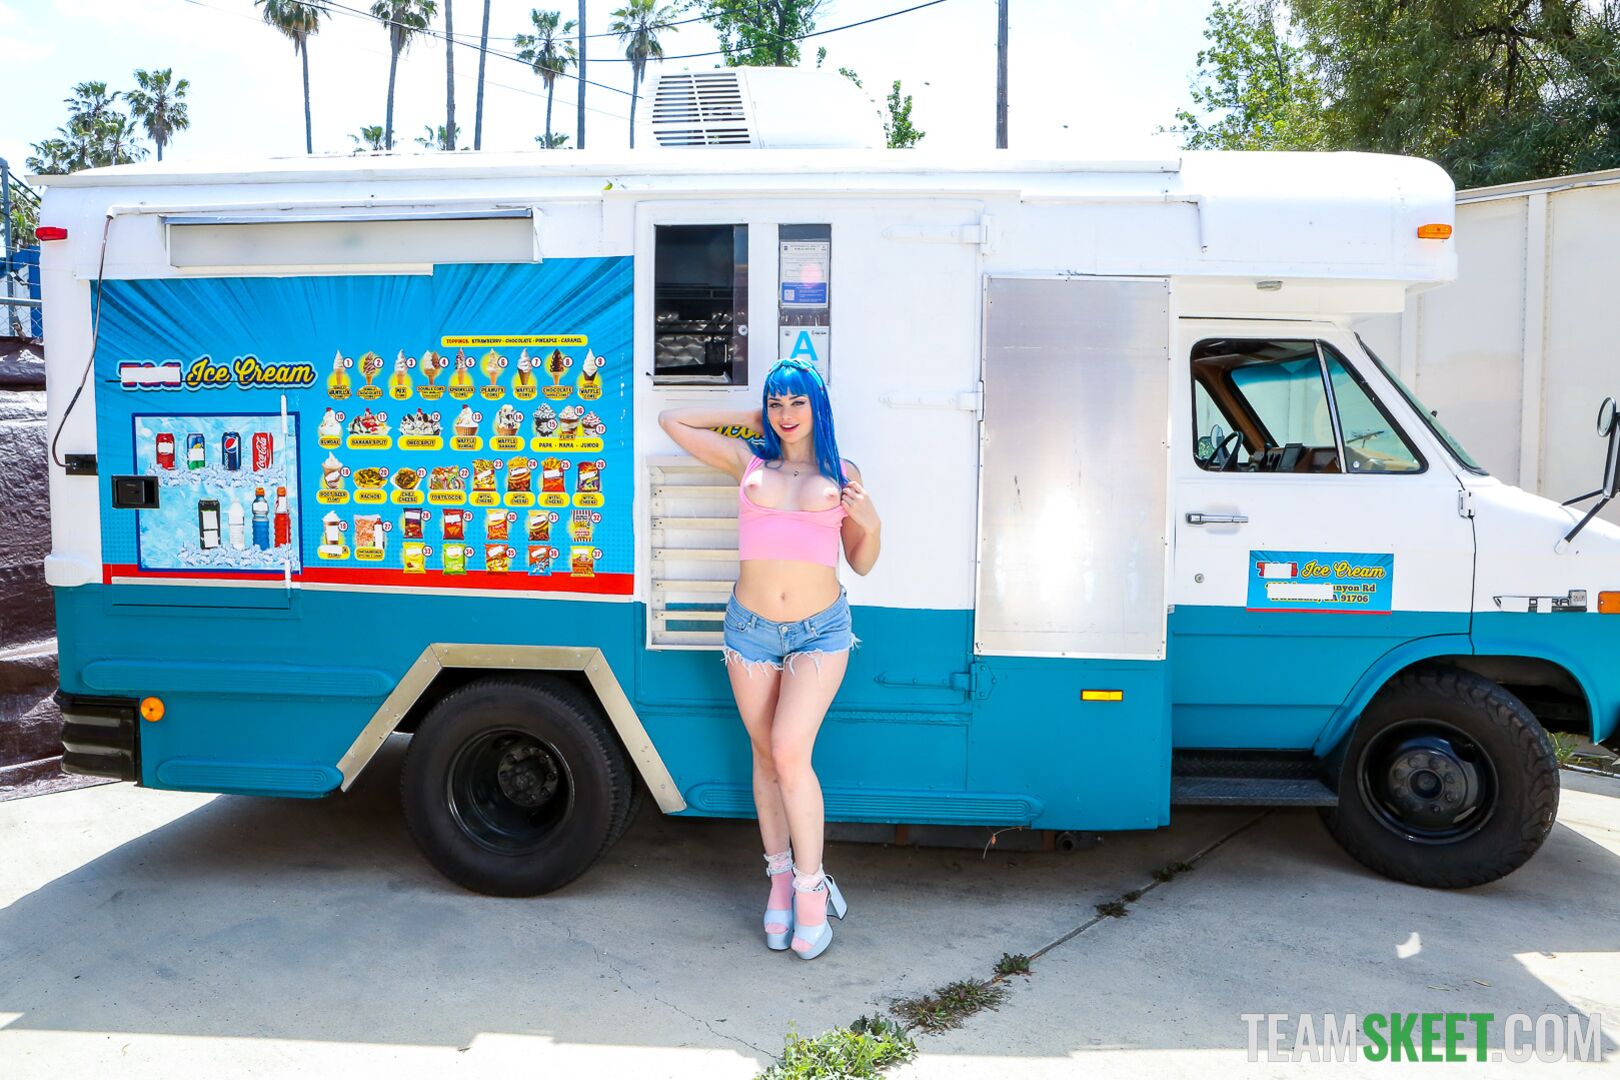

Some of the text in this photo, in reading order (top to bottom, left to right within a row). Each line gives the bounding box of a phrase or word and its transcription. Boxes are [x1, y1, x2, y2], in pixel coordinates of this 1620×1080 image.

[790, 331, 818, 361] A
[186, 357, 230, 386] Ice
[235, 356, 314, 384] Cream
[1301, 560, 1331, 578] Ice
[1333, 560, 1386, 579] Cream
[1362, 584, 1376, 592] Rd
[1341, 594, 1369, 602] 91706
